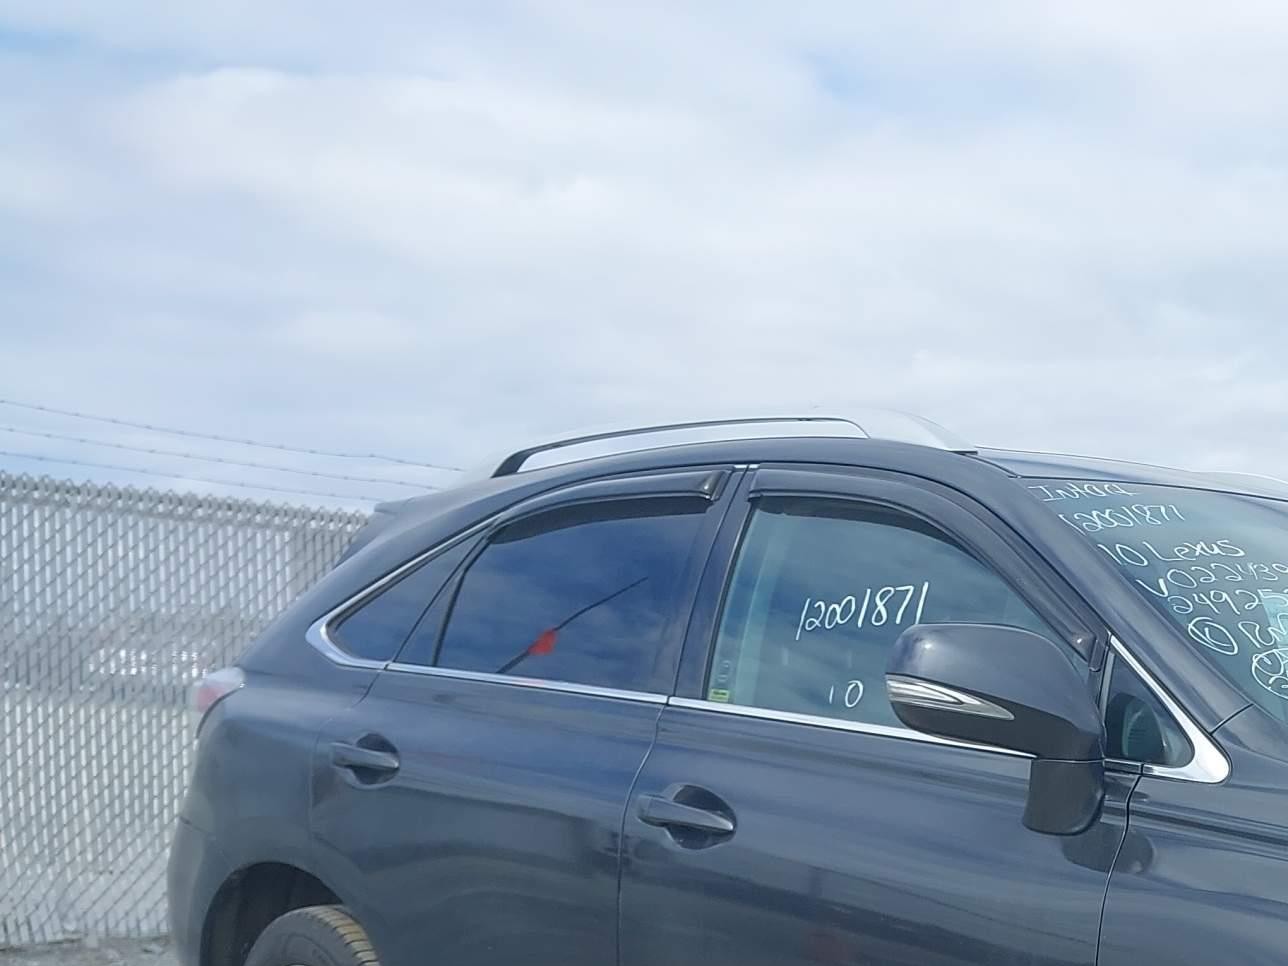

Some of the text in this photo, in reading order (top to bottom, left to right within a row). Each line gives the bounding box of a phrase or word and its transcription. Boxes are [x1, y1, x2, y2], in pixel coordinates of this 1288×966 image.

[1058, 504, 1186, 536] 12001871
[1097, 539, 1246, 566] 10 Lexus
[796, 581, 929, 640] 12001871
